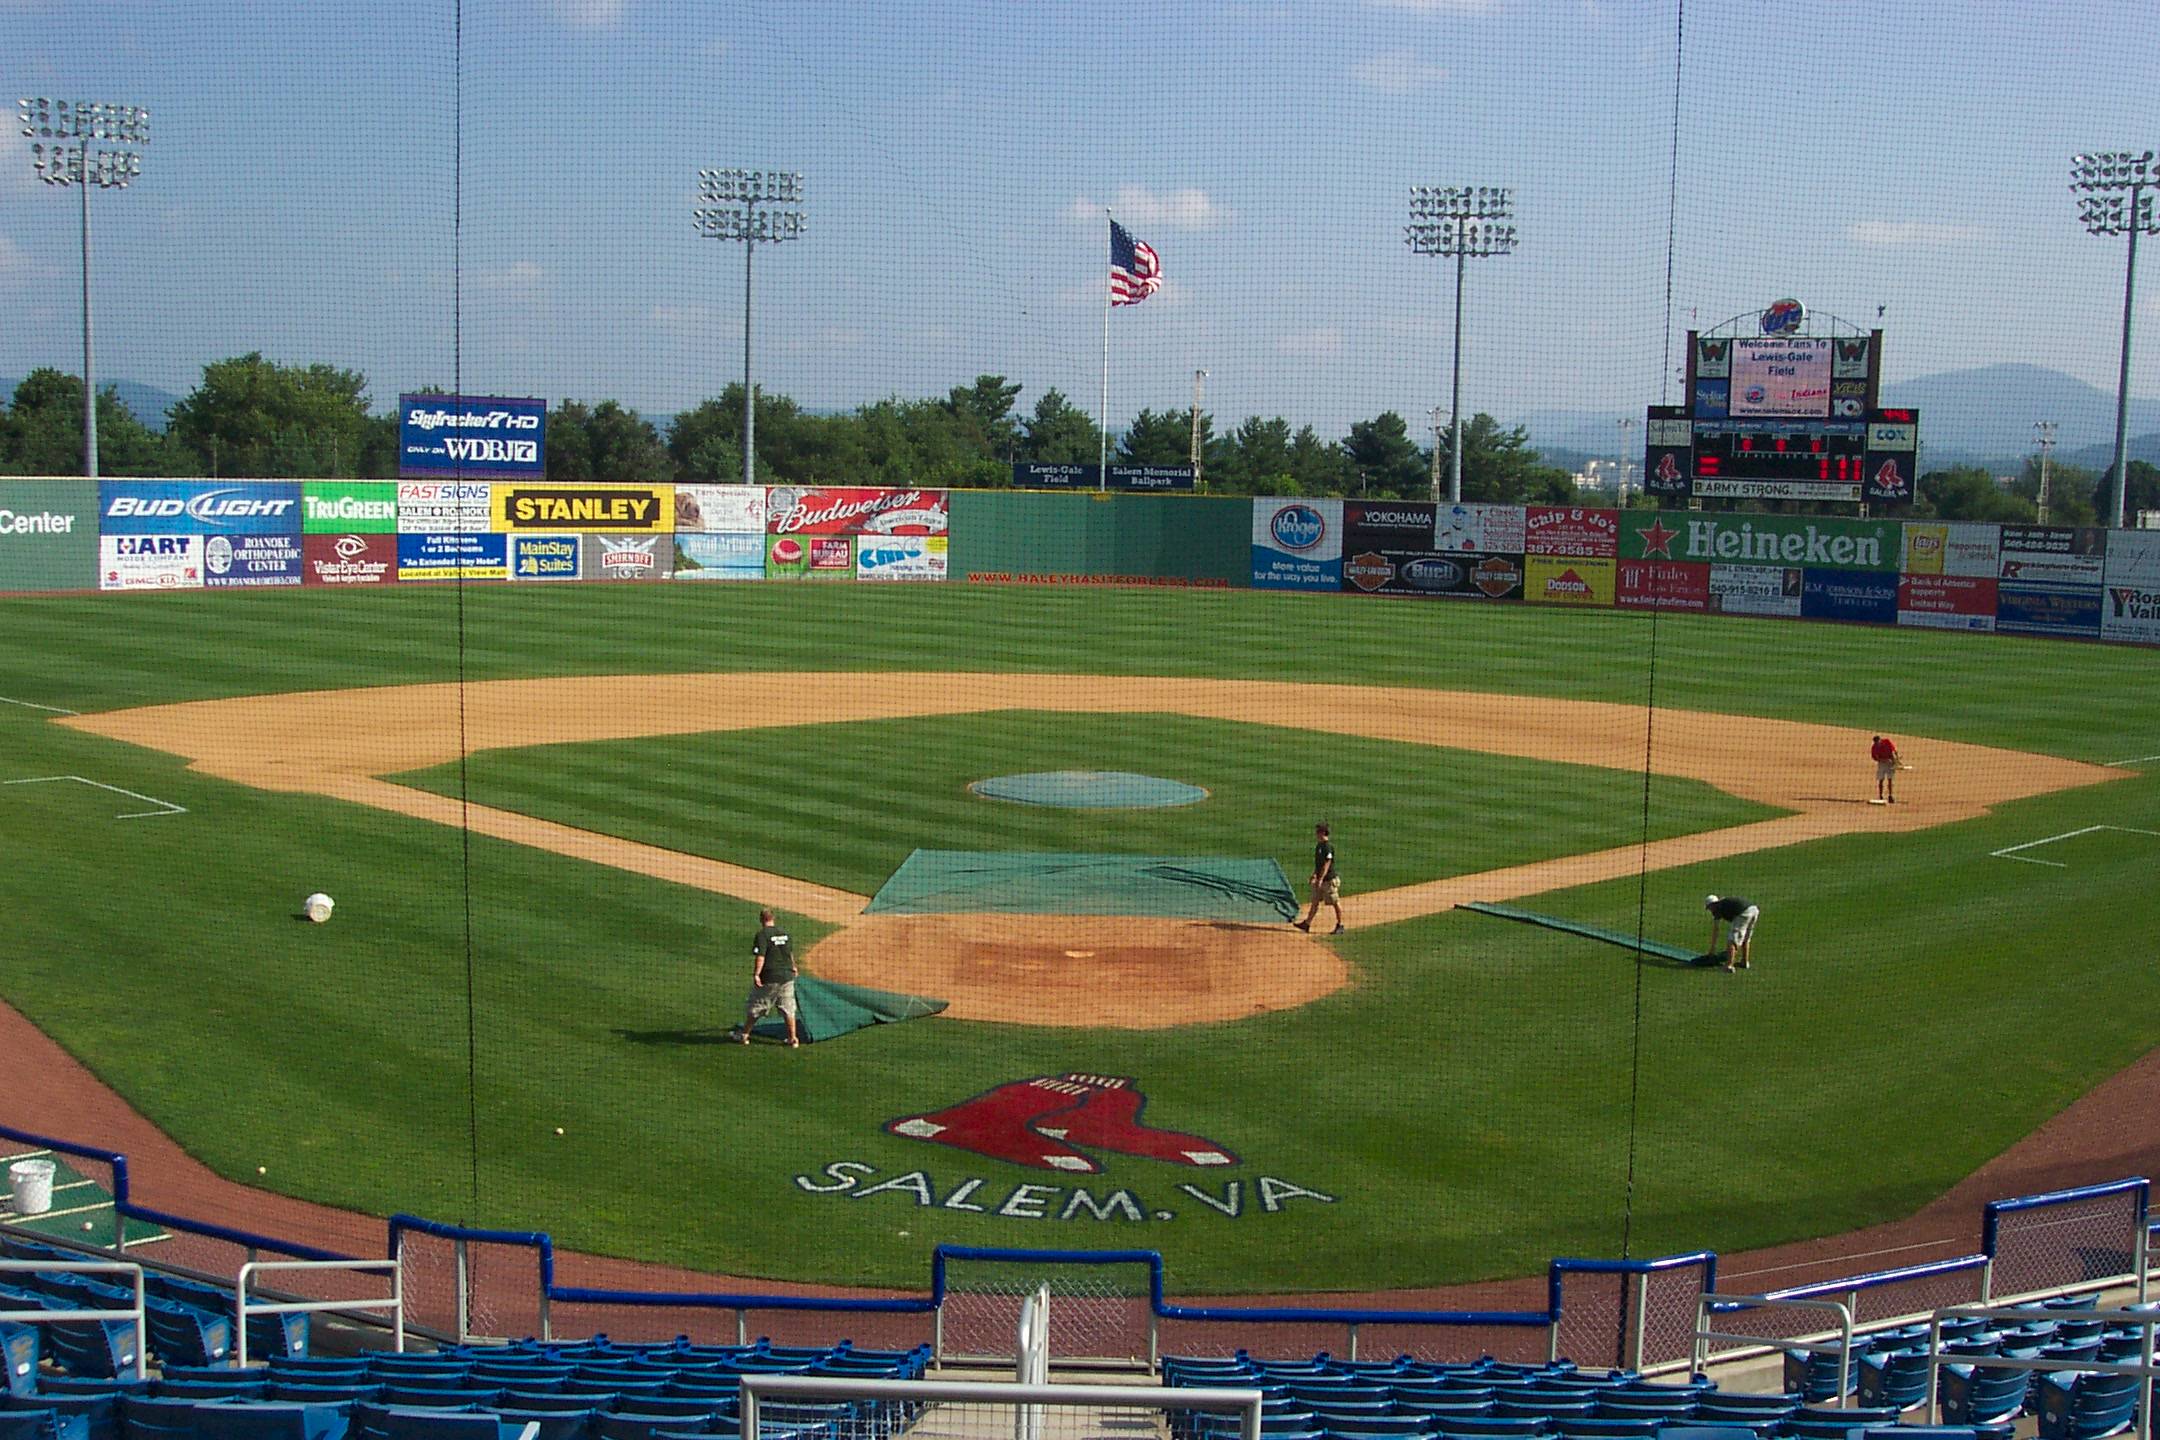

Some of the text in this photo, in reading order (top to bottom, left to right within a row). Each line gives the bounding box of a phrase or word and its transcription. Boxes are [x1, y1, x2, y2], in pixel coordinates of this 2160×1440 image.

[1739, 340, 1827, 349] Welcome Fans To
[1751, 352, 1814, 362] Lewis-Gale
[1768, 366, 1796, 376] Field
[1792, 388, 1828, 399] Indians
[506, 415, 539, 429] HD
[1876, 429, 1906, 441] COX
[407, 445, 429, 454] ONLY
[431, 446, 446, 454] ON
[1029, 464, 1083, 475] Lewis-Gale
[1112, 466, 1192, 477] Salem Memorial
[1043, 474, 1069, 484] Field
[1131, 478, 1172, 487] Ballpark
[400, 485, 489, 499] FASTSIGNS
[1705, 483, 1739, 495] ARMY
[1742, 484, 1793, 497] STRONG.
[107, 497, 294, 517] BUD LIGHT
[398, 507, 490, 517] SALEM ROANOKE
[514, 497, 651, 521] STANLEY
[771, 491, 920, 534] Budweiser
[0, 509, 75, 534] Center
[1365, 511, 1432, 524] YOKOHAMA
[1528, 510, 1565, 529] Chip
[1570, 508, 1584, 521] &
[1588, 513, 1617, 534] Jo's
[1277, 511, 1321, 545] Kroger
[117, 537, 190, 554] HART
[244, 537, 291, 549] ROANOKE
[427, 536, 442, 545] Full
[822, 541, 848, 549] FARM
[1686, 520, 1881, 566] Heineken
[234, 548, 302, 560] ORTHOPAEDIC
[519, 541, 575, 559] MainStay
[812, 549, 848, 559] BUREAU
[419, 558, 456, 566] Extended
[540, 557, 574, 572] Suites
[606, 552, 650, 565] SMIRNOFF
[248, 560, 287, 572] CENTER
[358, 560, 389, 574] Center
[1272, 562, 1321, 572] More value
[1411, 563, 1454, 578] Buell
[400, 569, 432, 577] Located
[489, 568, 506, 576] Mall
[612, 567, 646, 579] ICE
[1254, 571, 1339, 583] for the way you live.
[125, 577, 157, 585] GMC
[1911, 577, 1977, 588] Bank of America
[1910, 599, 1955, 611] United Way
[1178, 1176, 1336, 1218] VA
